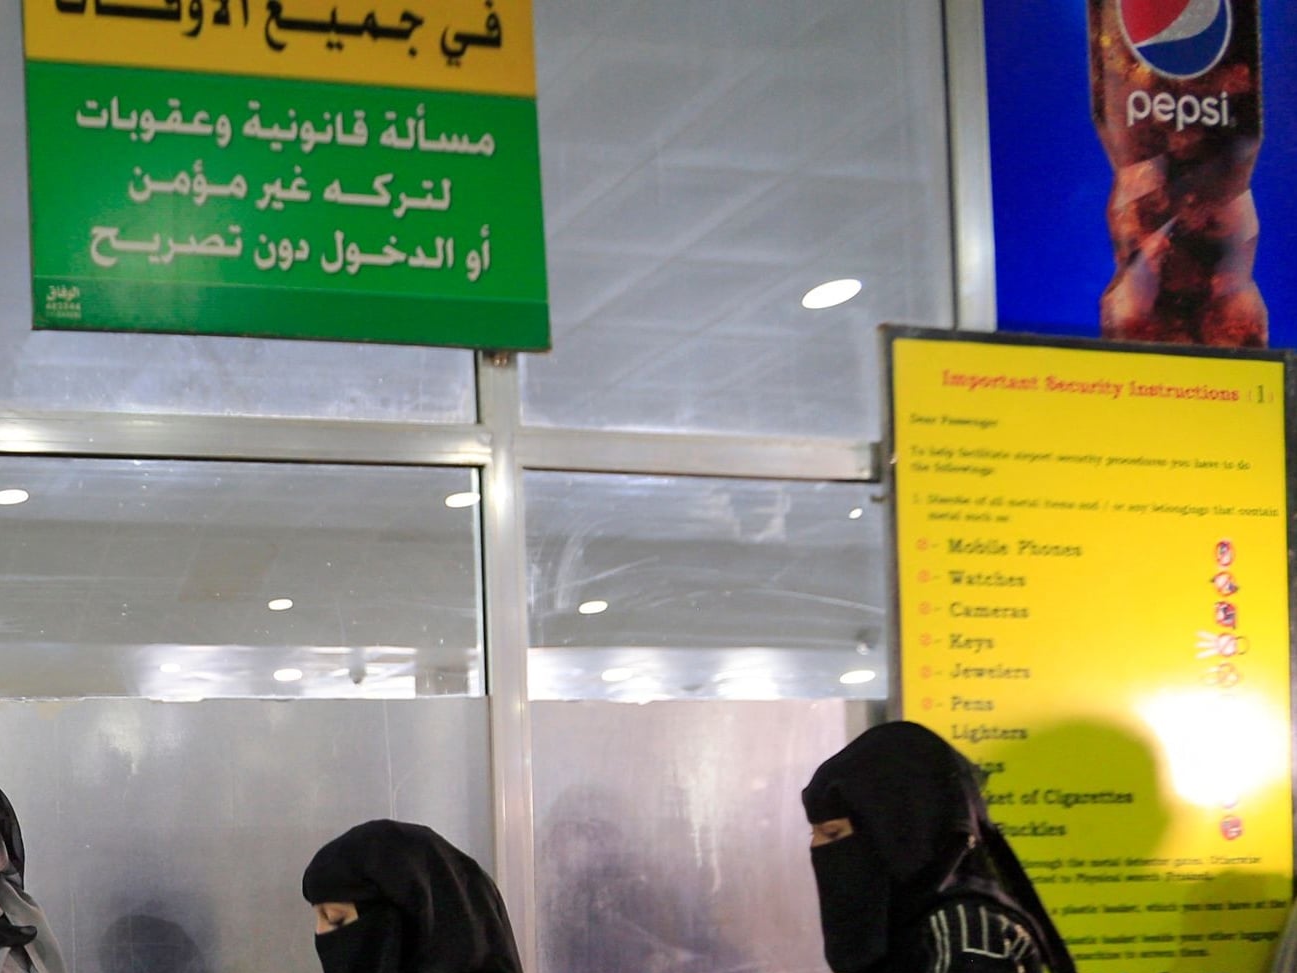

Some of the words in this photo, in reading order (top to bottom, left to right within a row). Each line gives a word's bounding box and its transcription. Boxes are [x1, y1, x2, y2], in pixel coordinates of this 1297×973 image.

[265, 6, 424, 57] جميع
[76, 96, 232, 148] وعقوبات
[242, 100, 369, 154] قانونية
[379, 103, 495, 157] مسألة
[1127, 90, 1229, 132] pepsi
[128, 160, 247, 206] مؤمن
[255, 165, 311, 211] غير
[323, 173, 451, 218] لتركه
[90, 224, 243, 267] تصريح
[254, 233, 310, 271] دون
[320, 230, 454, 275] الدخول
[466, 224, 490, 282] أو
[942, 369, 1038, 391] Important
[1045, 375, 1123, 399] Security
[1129, 381, 1240, 402] Instructions
[948, 537, 1009, 556] Mobile
[1017, 539, 1083, 558] Phones
[948, 569, 1028, 588] Watches
[948, 600, 1032, 619] Cameras
[948, 632, 996, 654] Keys
[950, 695, 995, 712] Pens
[951, 724, 1029, 744] Lighters
[1021, 787, 1039, 805] of
[1043, 789, 1134, 809] Cigarettes
